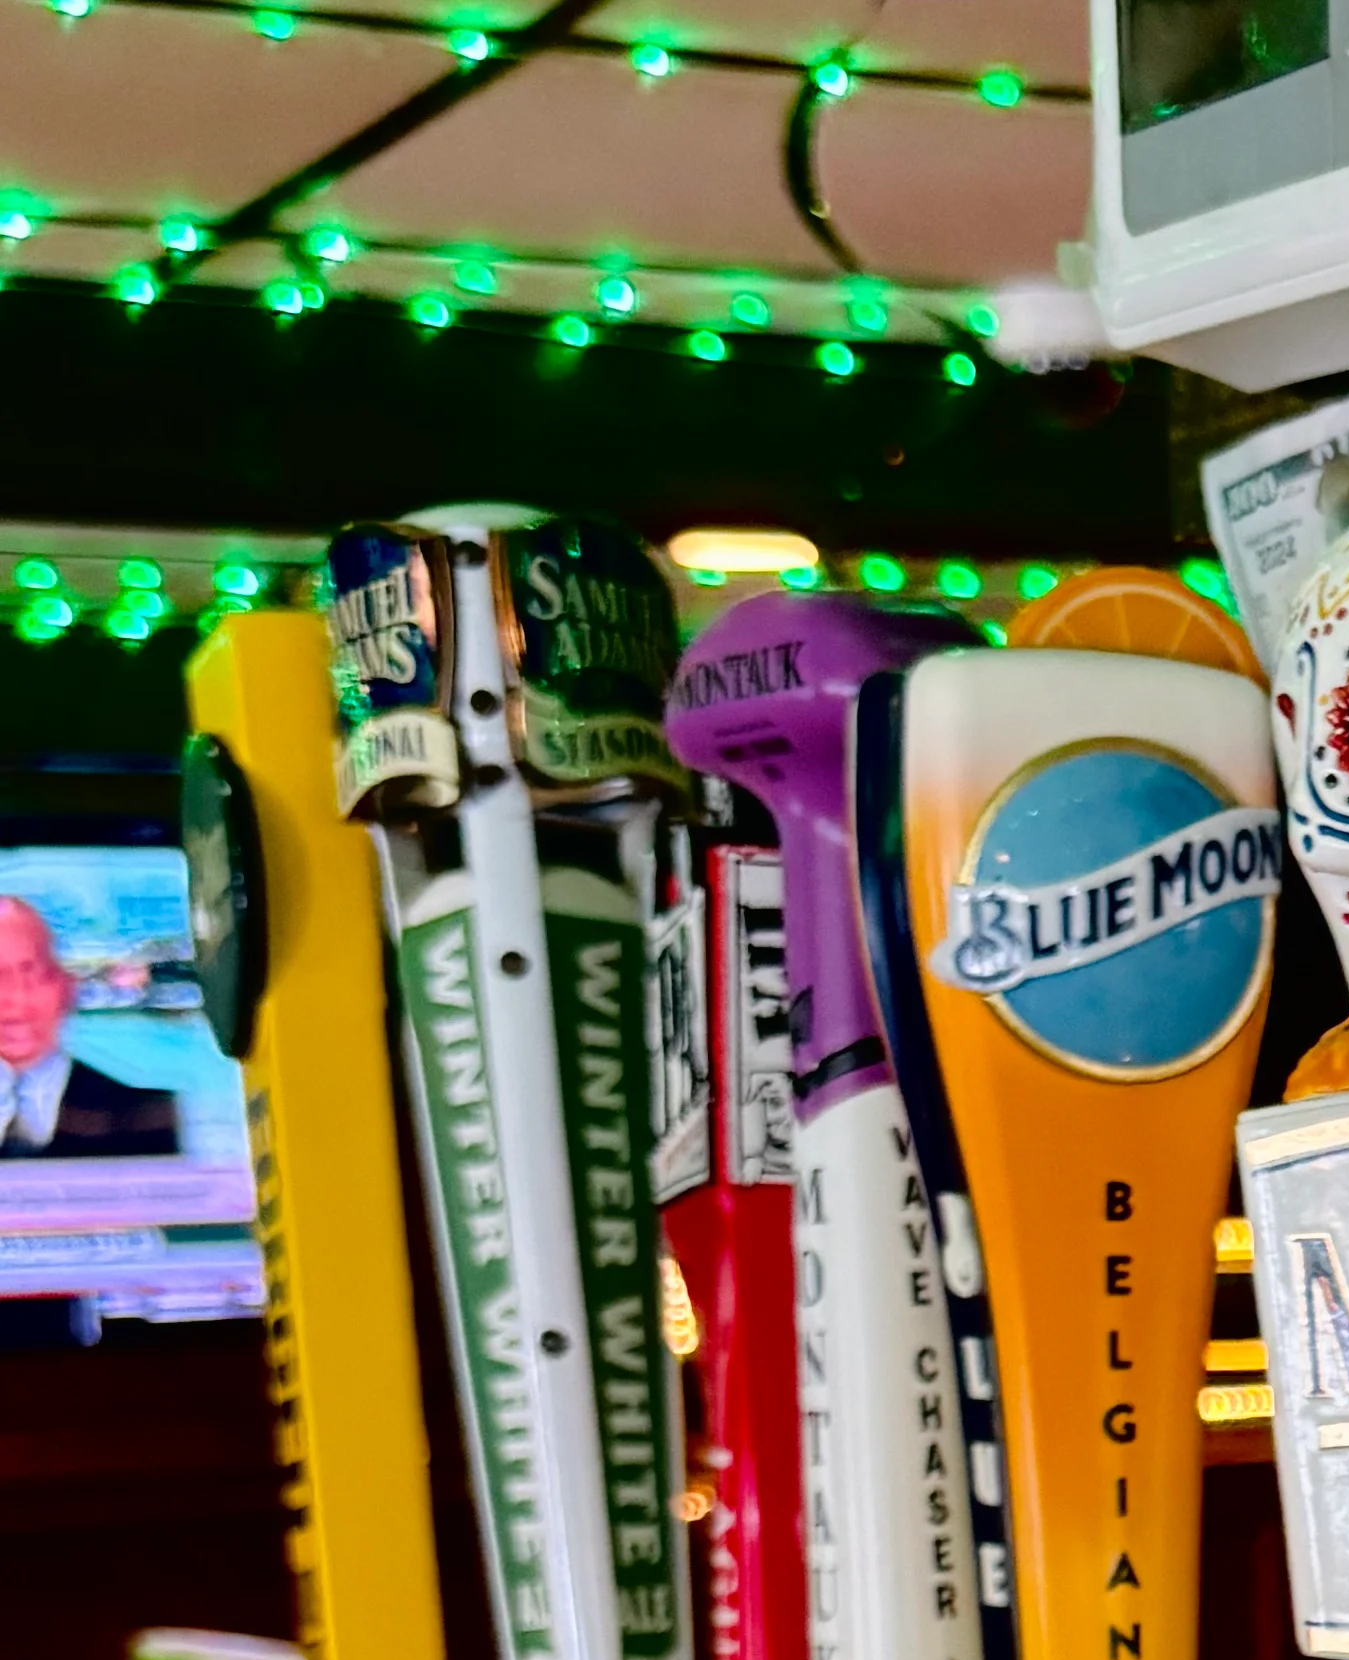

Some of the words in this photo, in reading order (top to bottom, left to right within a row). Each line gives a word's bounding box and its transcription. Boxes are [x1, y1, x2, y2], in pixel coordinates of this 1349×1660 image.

[954, 876, 1136, 984] BLUE
[1148, 820, 1283, 920] MOON
[420, 924, 512, 1268] WINTER
[576, 939, 640, 1269] WINTER
[600, 1295, 664, 1565] WHITE
[914, 1348, 958, 1621] CHASER
